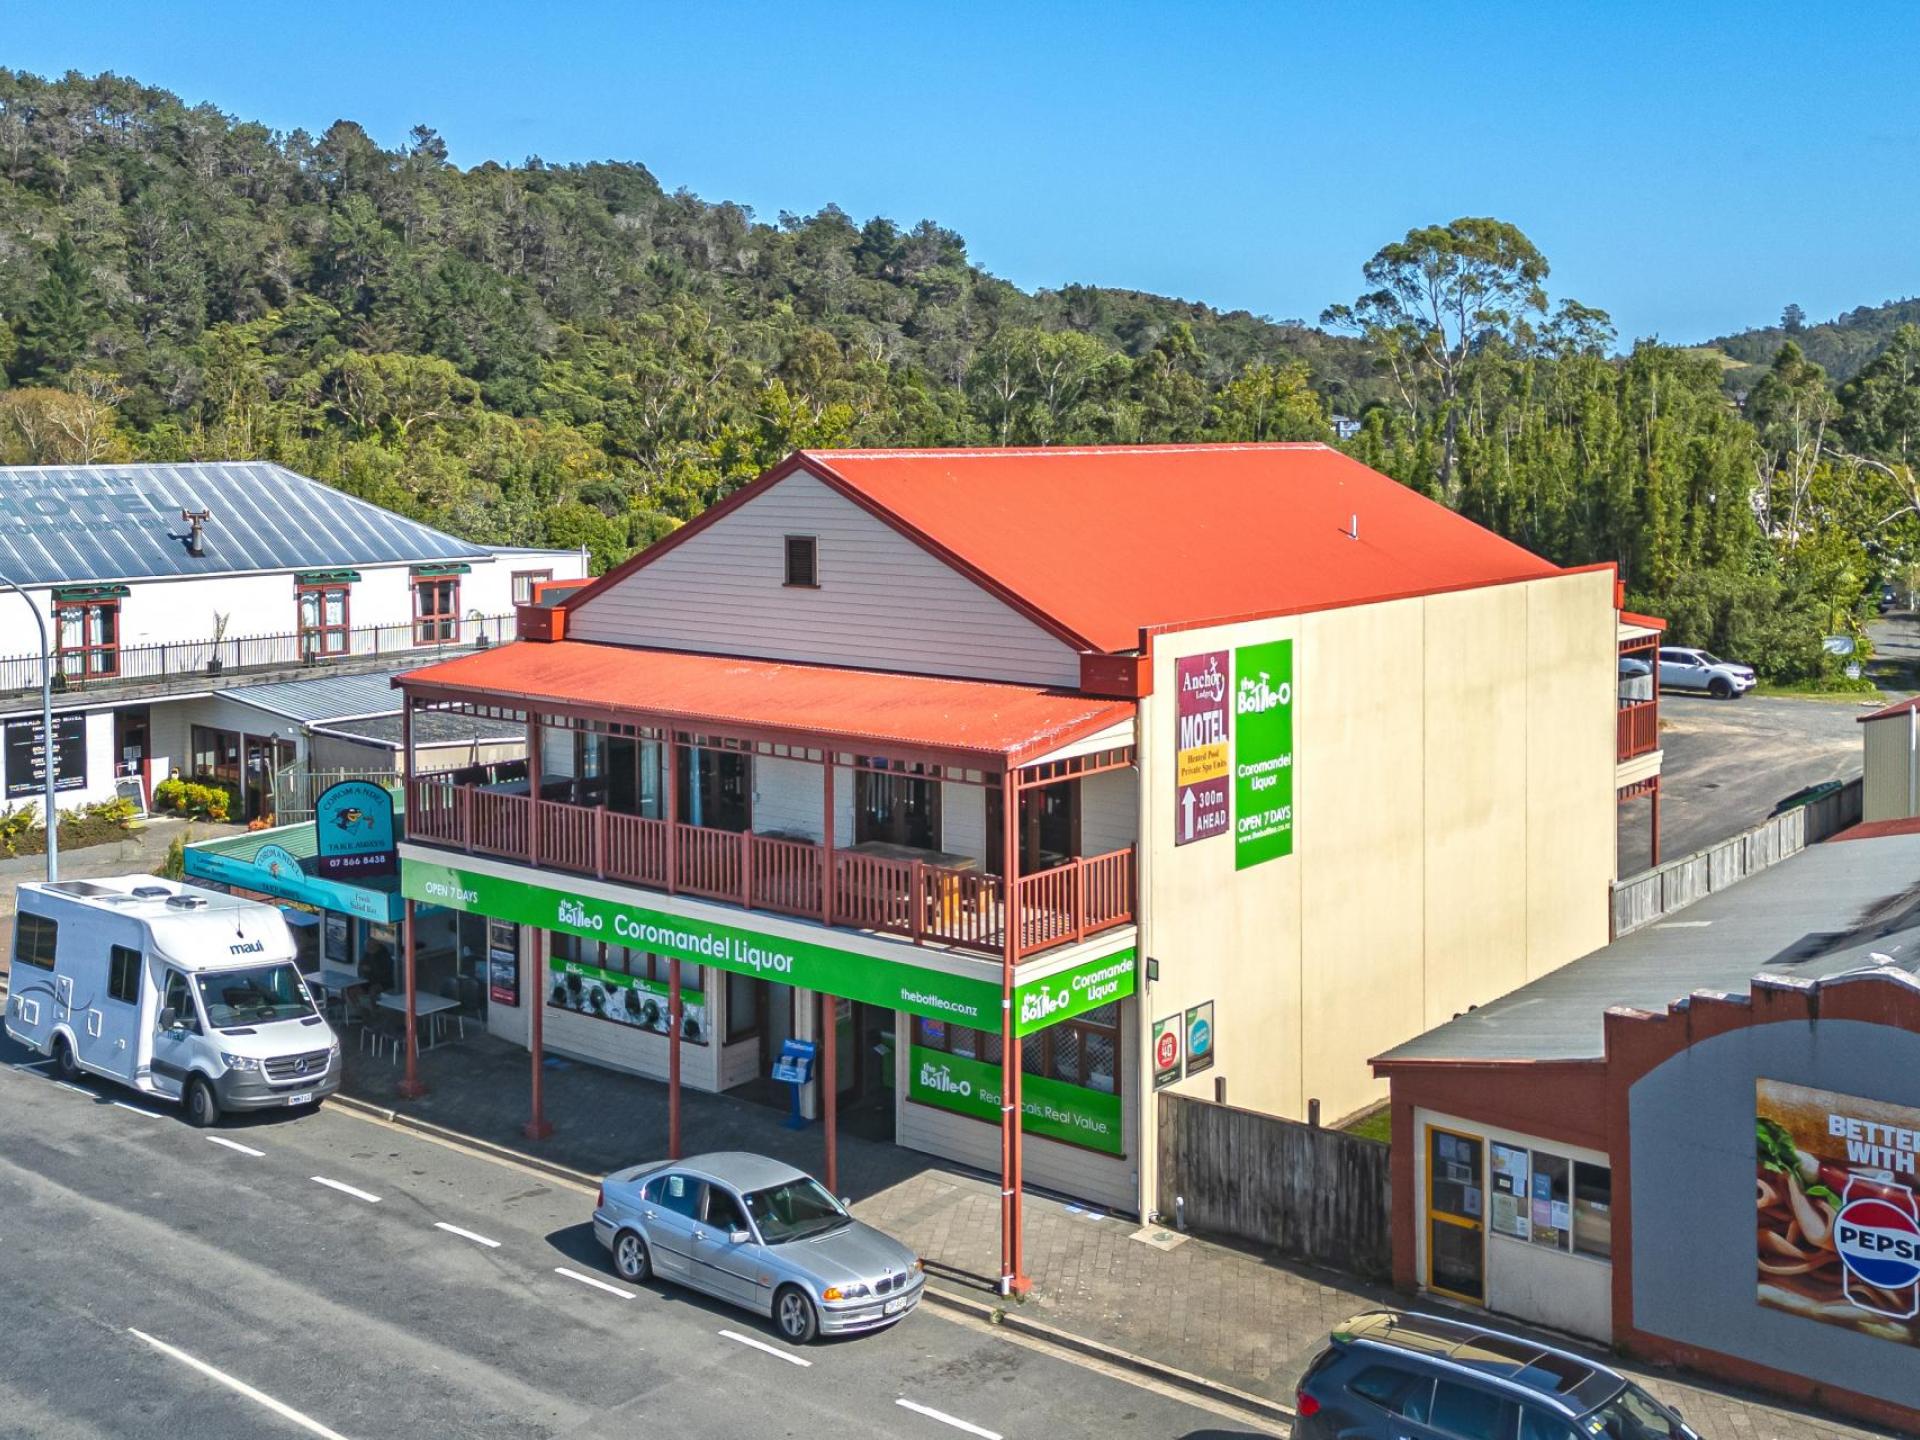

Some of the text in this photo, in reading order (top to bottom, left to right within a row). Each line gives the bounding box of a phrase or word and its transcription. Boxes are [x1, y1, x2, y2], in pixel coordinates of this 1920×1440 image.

[1183, 669, 1221, 692] Anchor
[1181, 709, 1227, 749] MOTEL
[1181, 765, 1201, 776] Private
[1238, 752, 1291, 777] Coromandel
[1251, 774, 1277, 791] Liquor
[323, 787, 385, 811] COROMANDEL
[1199, 790, 1223, 808] 300m
[1196, 809, 1226, 832] AHEAD
[1238, 805, 1291, 832] OPEN 7 DAYS
[329, 855, 386, 867] 07 866 8438
[424, 881, 478, 903] OPEN 7 DAYS
[560, 898, 572, 909] the
[229, 940, 265, 955] maui
[614, 914, 729, 960] Coromandel
[734, 939, 794, 973] Liquor
[1087, 979, 1119, 1001] Liquor
[900, 987, 978, 1017] thebottleo.co.nz
[923, 1061, 937, 1073] the
[979, 1088, 1001, 1105] Rea
[1045, 1106, 1070, 1124] Real
[1073, 1115, 1110, 1135] Value.
[1847, 1140, 1915, 1175] WITH
[1840, 1225, 1920, 1262] PEPSI
